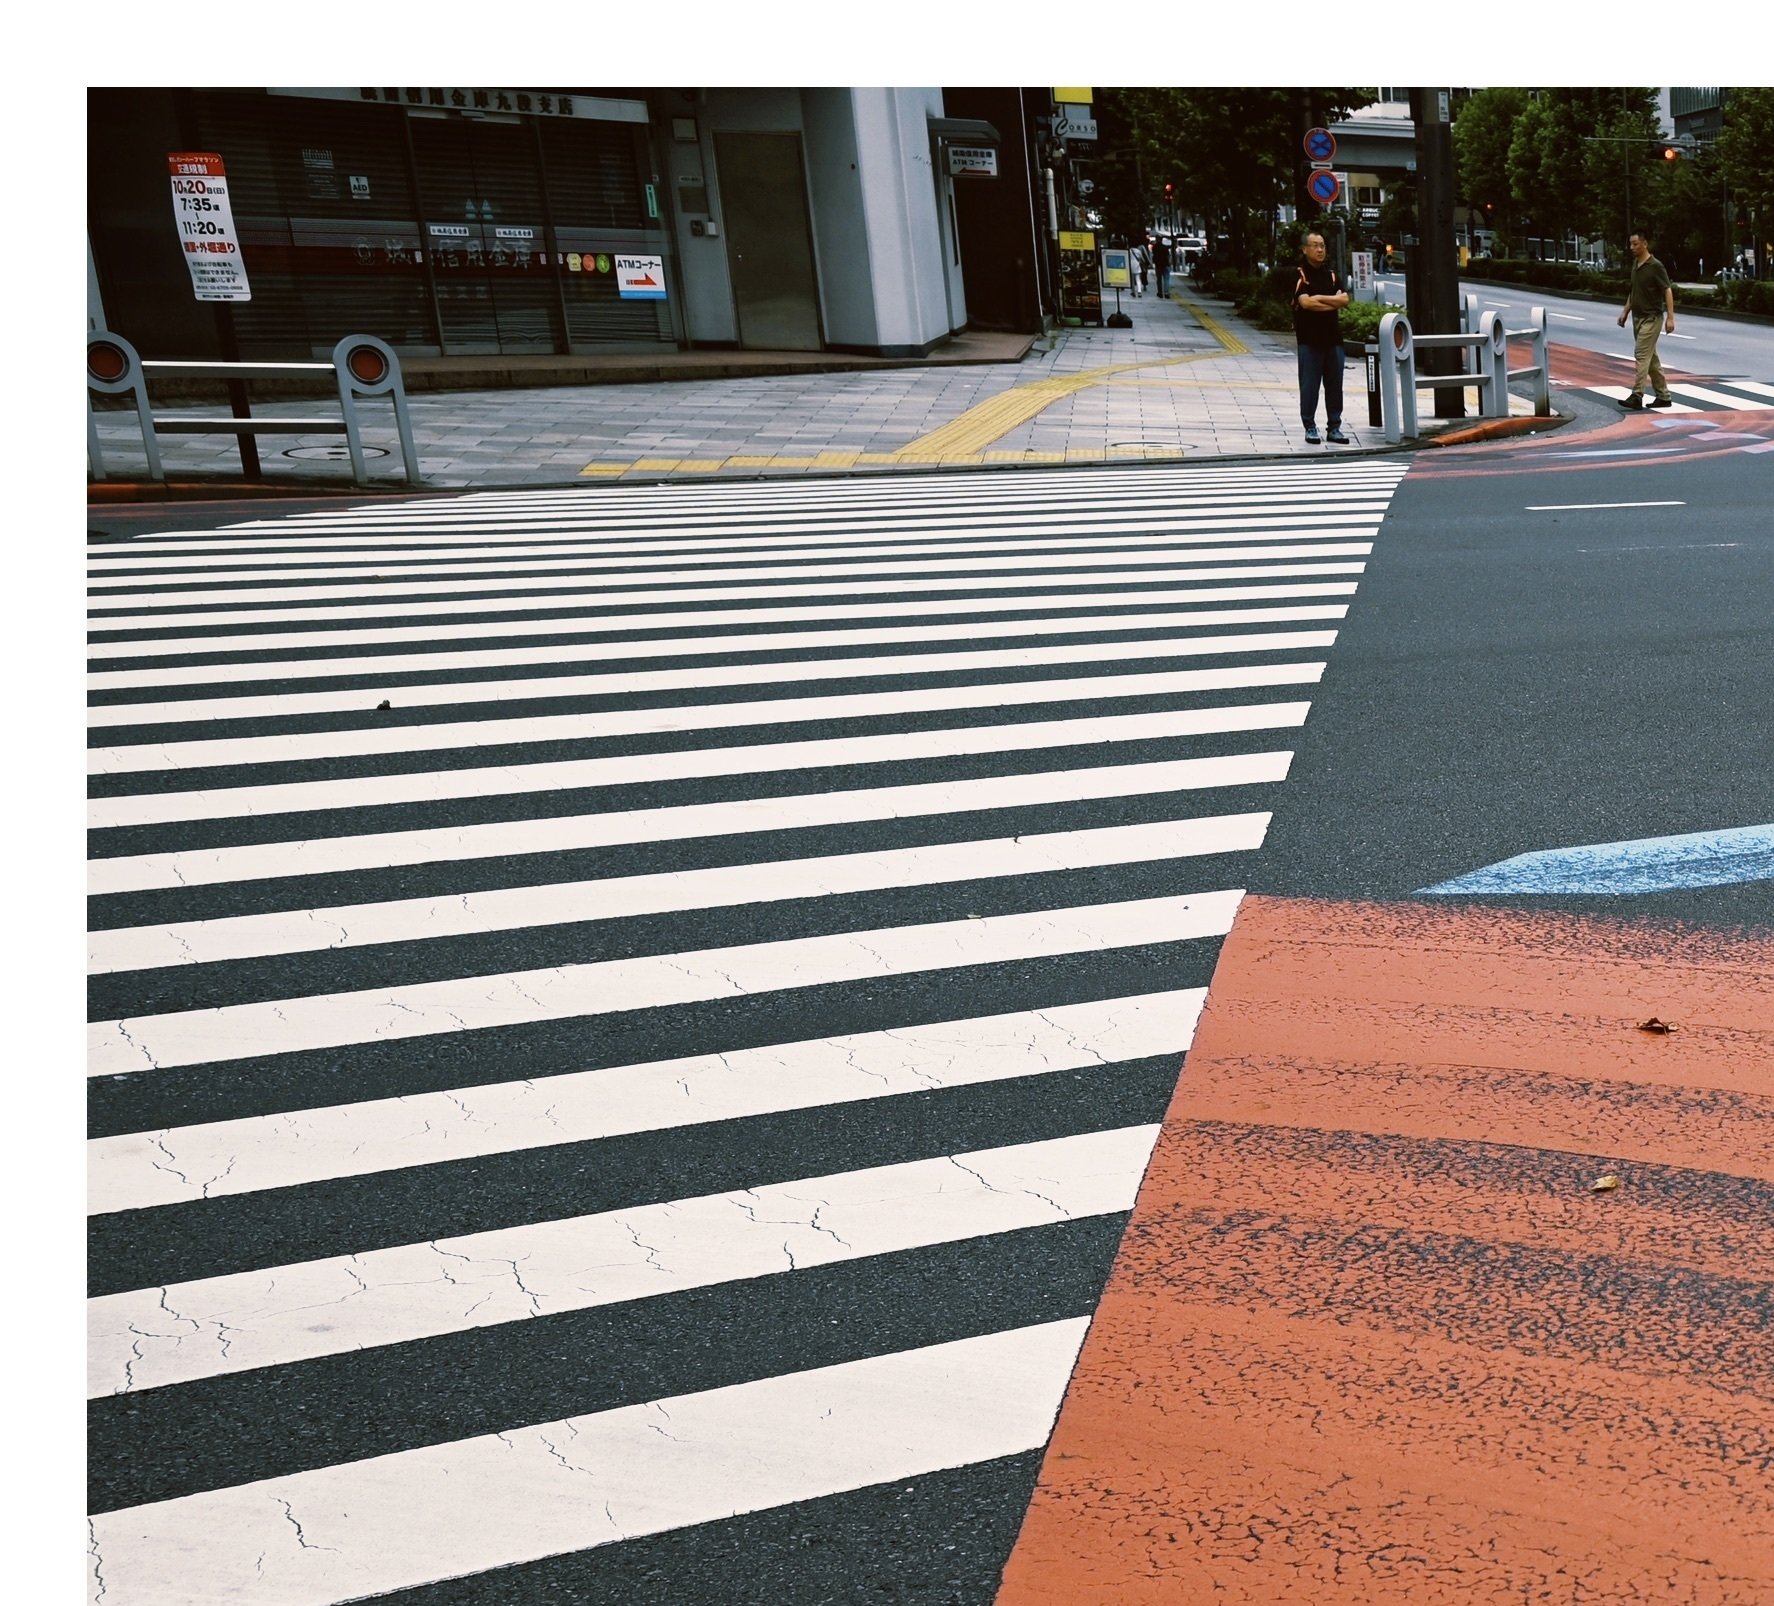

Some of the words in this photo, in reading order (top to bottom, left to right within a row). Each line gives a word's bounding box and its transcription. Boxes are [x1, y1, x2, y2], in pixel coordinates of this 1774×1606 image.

[352, 184, 367, 192] AED
[384, 239, 531, 271] 城信用金庫
[617, 259, 661, 270] ATMコーナー
